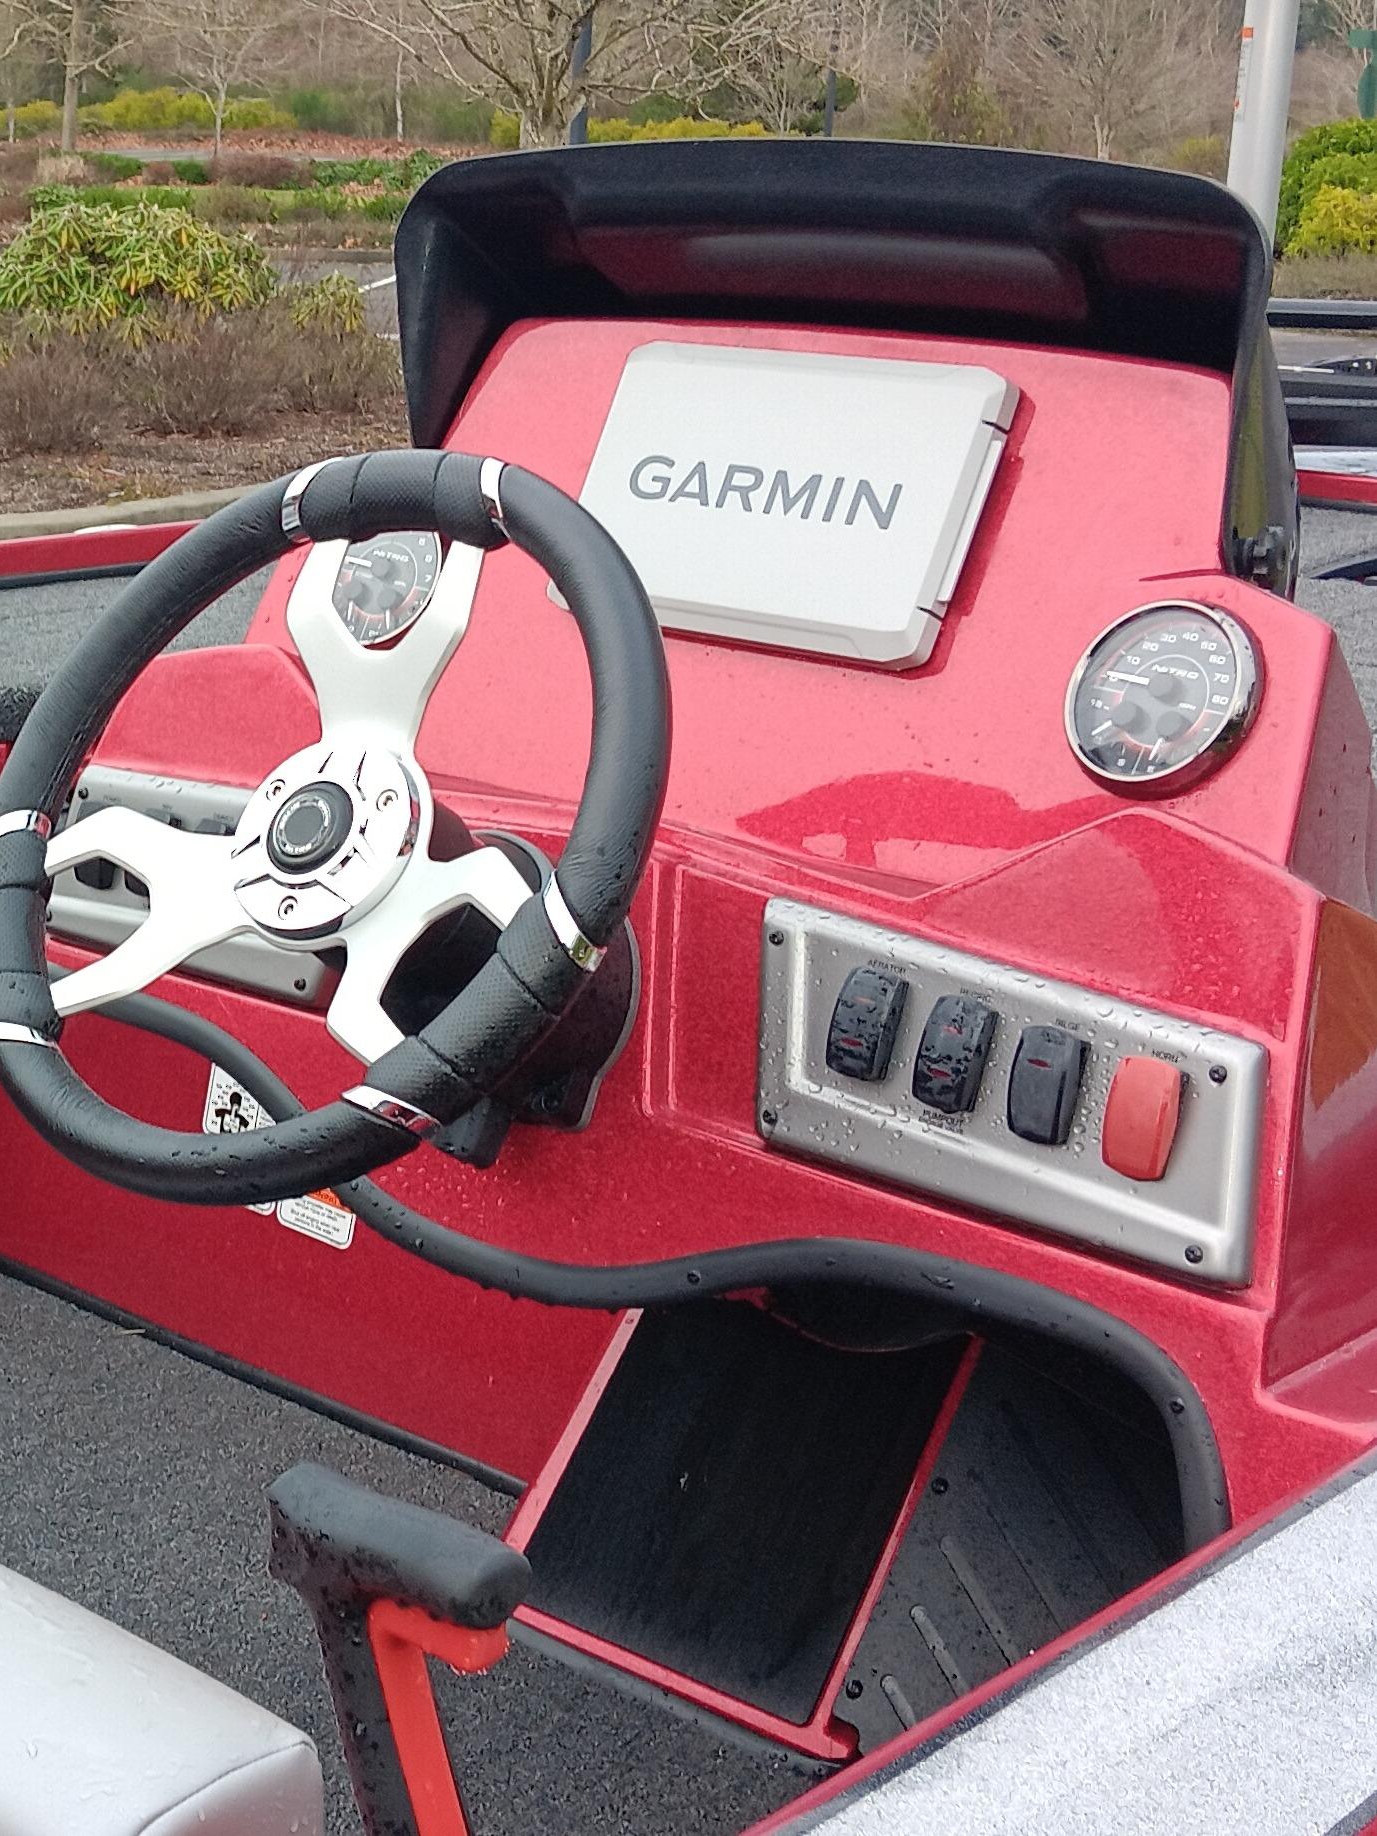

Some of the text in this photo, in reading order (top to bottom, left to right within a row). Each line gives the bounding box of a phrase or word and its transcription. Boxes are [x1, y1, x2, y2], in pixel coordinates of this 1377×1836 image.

[629, 455, 904, 530] GARMIN
[1160, 633, 1177, 644] 30
[1182, 631, 1200, 642] 40
[1142, 641, 1159, 652] 20
[1200, 641, 1218, 651] 50
[1126, 655, 1141, 666] 10
[1209, 654, 1227, 665] 60
[1151, 663, 1199, 680] NITRO
[1213, 672, 1230, 684] 70
[1212, 694, 1229, 705] 80
[1151, 1048, 1180, 1063] HORN
